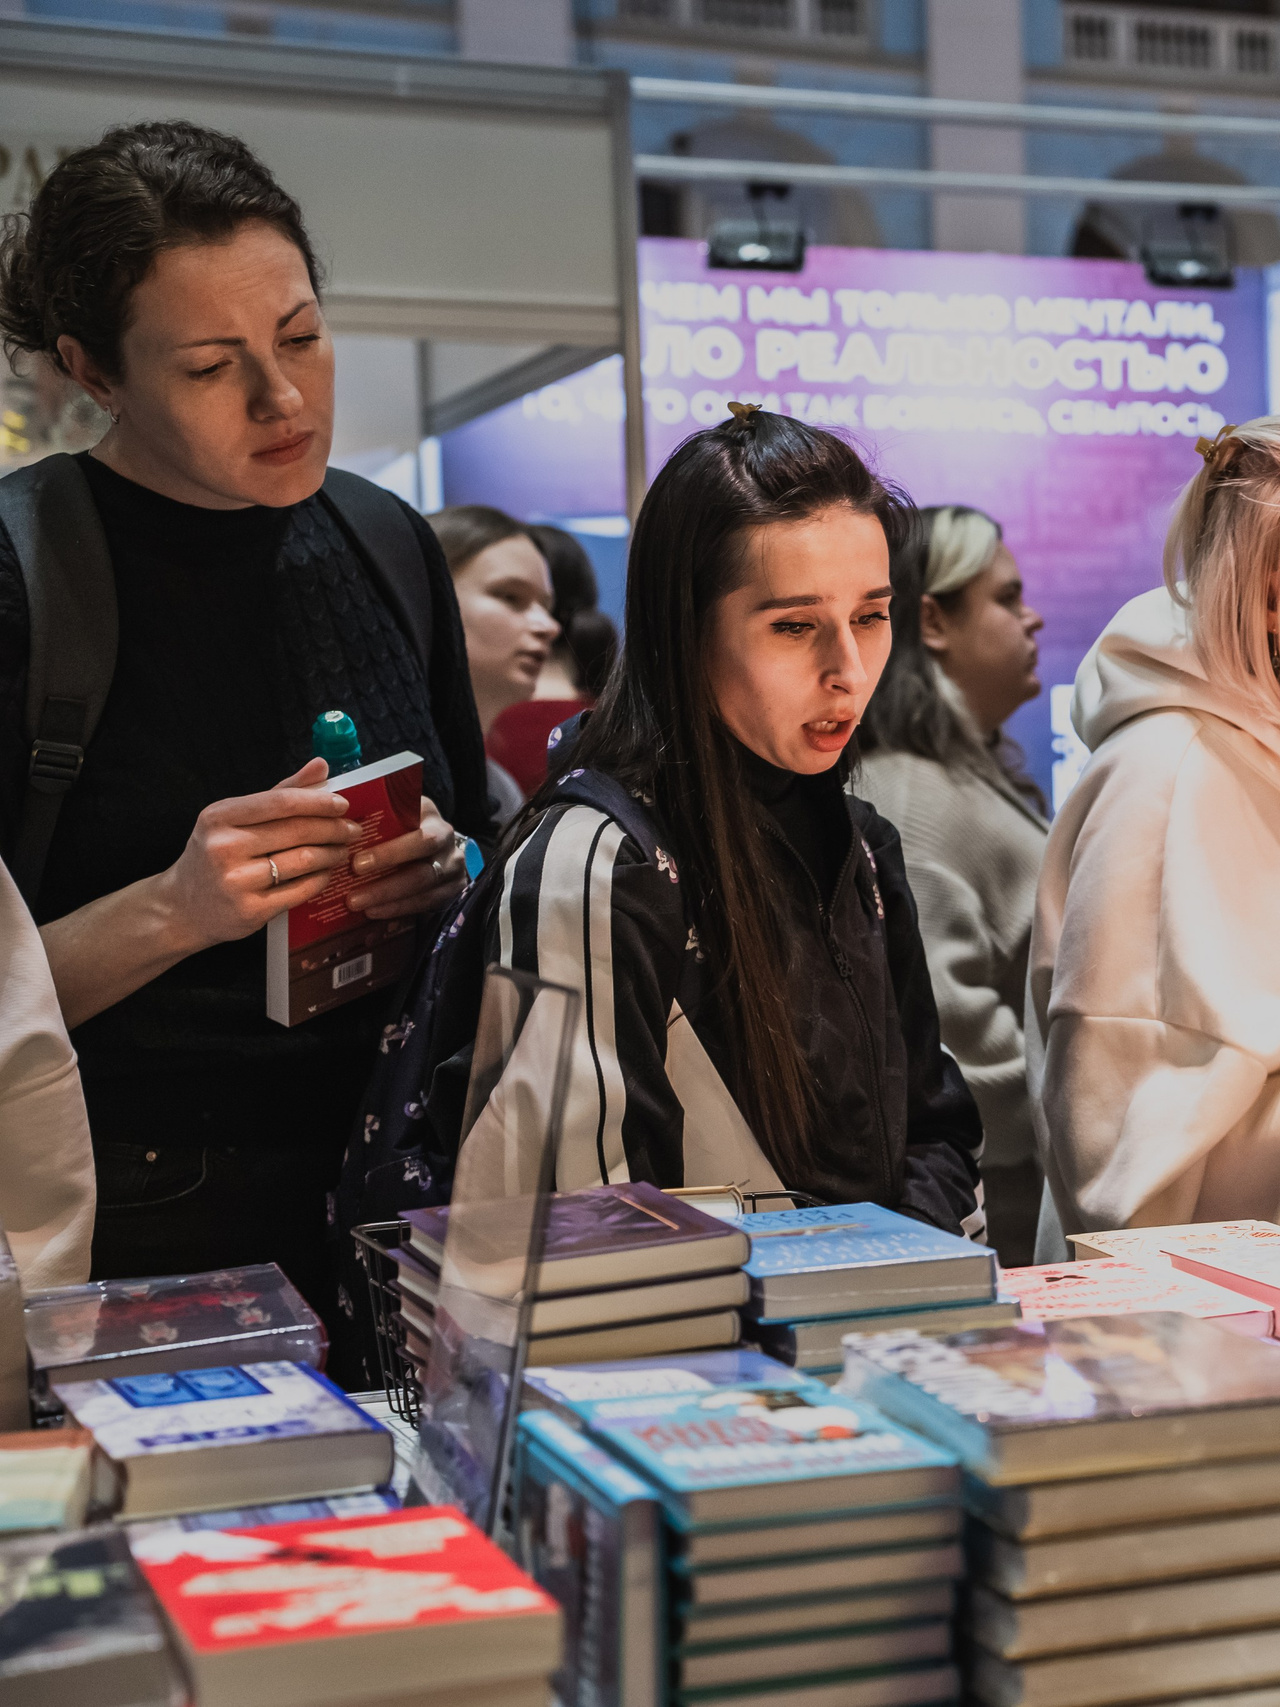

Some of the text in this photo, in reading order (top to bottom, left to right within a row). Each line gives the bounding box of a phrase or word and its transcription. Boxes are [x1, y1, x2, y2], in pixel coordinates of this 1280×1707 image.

[747, 285, 830, 326] МЫ
[834, 288, 1011, 334] ТОЛЬКО
[1014, 296, 1225, 345] МЕЧТАЛИ,
[641, 324, 1229, 395] ЛО РЕАЛЬНОСТЬЮ
